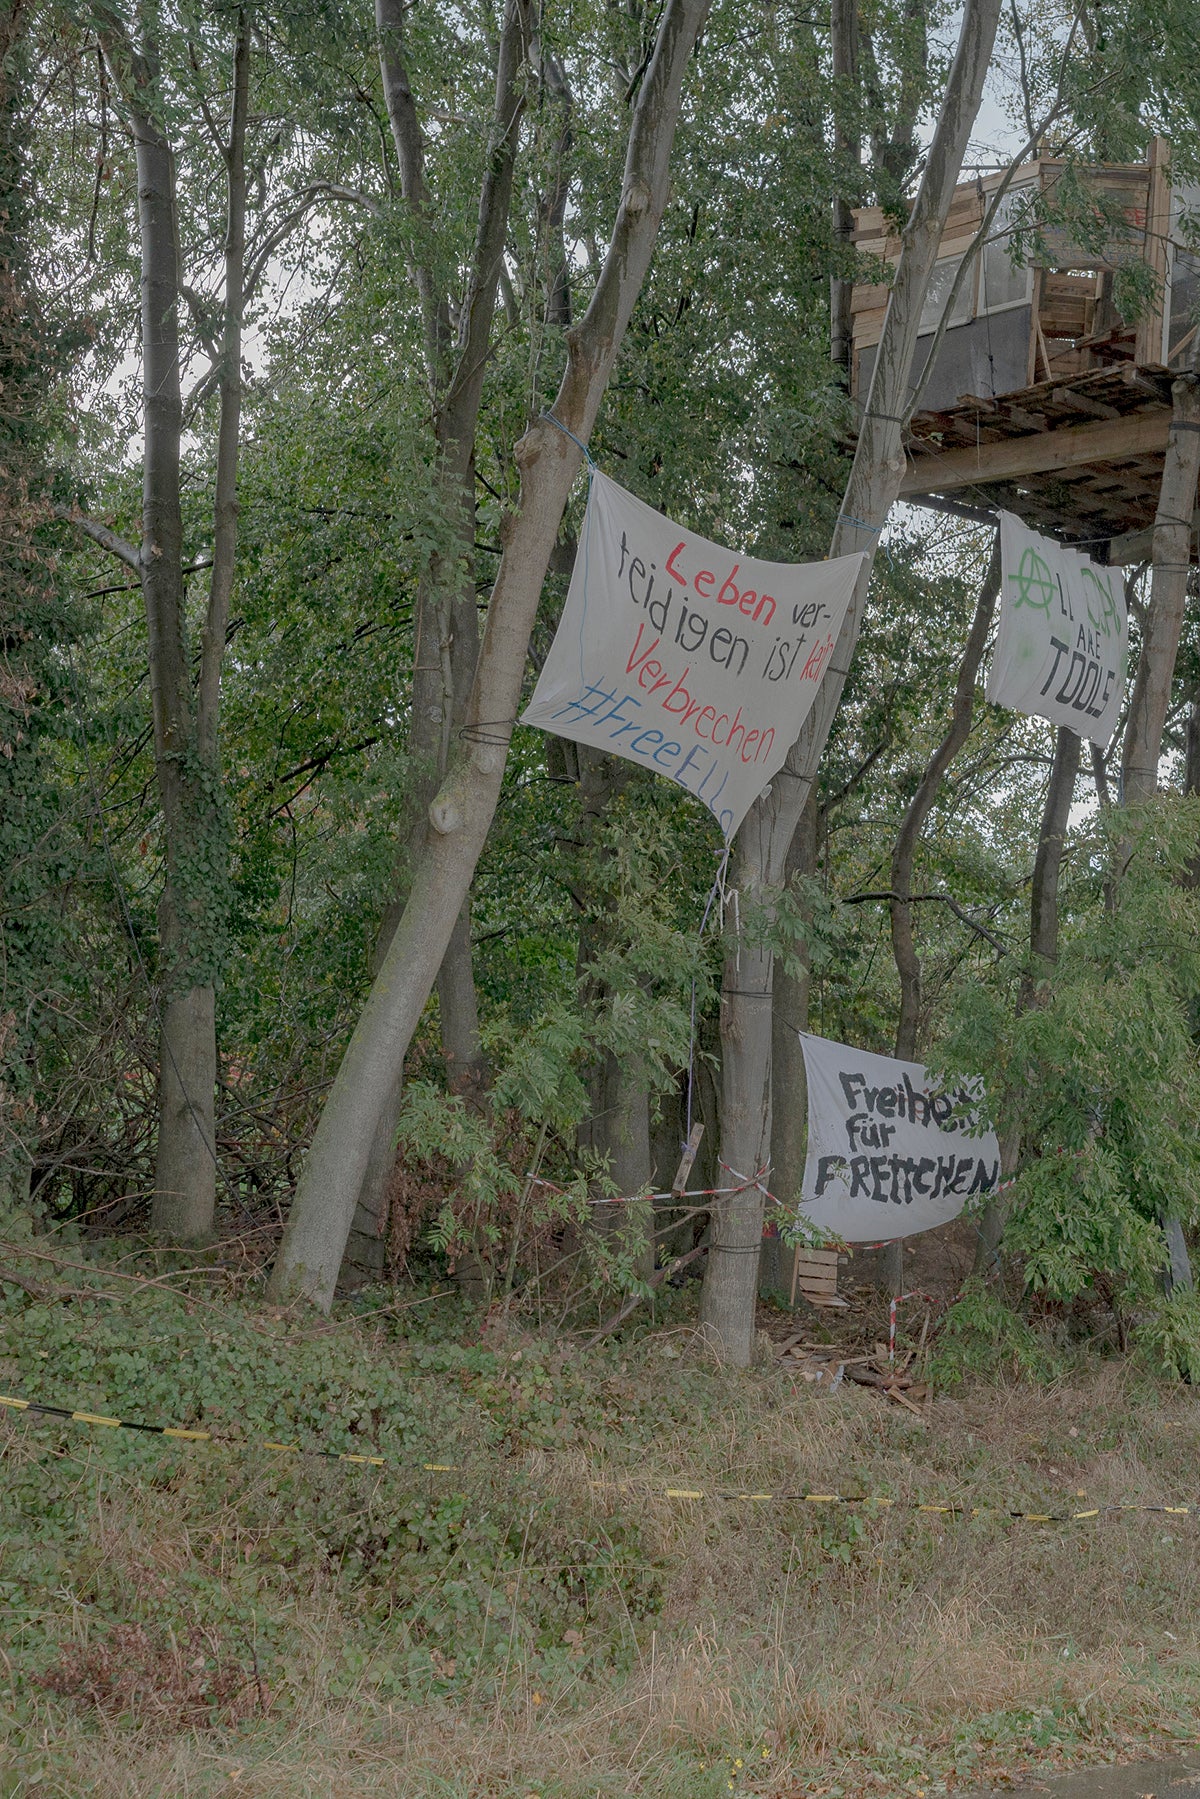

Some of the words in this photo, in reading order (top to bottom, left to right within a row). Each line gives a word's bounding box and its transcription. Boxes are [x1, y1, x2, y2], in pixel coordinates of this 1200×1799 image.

[617, 531, 750, 676] teidigen
[762, 636, 807, 683] ist
[799, 634, 835, 682] kein
[665, 541, 778, 627] Leben
[791, 601, 832, 629] ver-
[1039, 635, 1116, 720] TOOLS
[1076, 622, 1102, 661] ARE
[625, 622, 776, 765] Verbrechen
[845, 1112, 897, 1153] für
[813, 1153, 1000, 1206] FRETTCHEN
